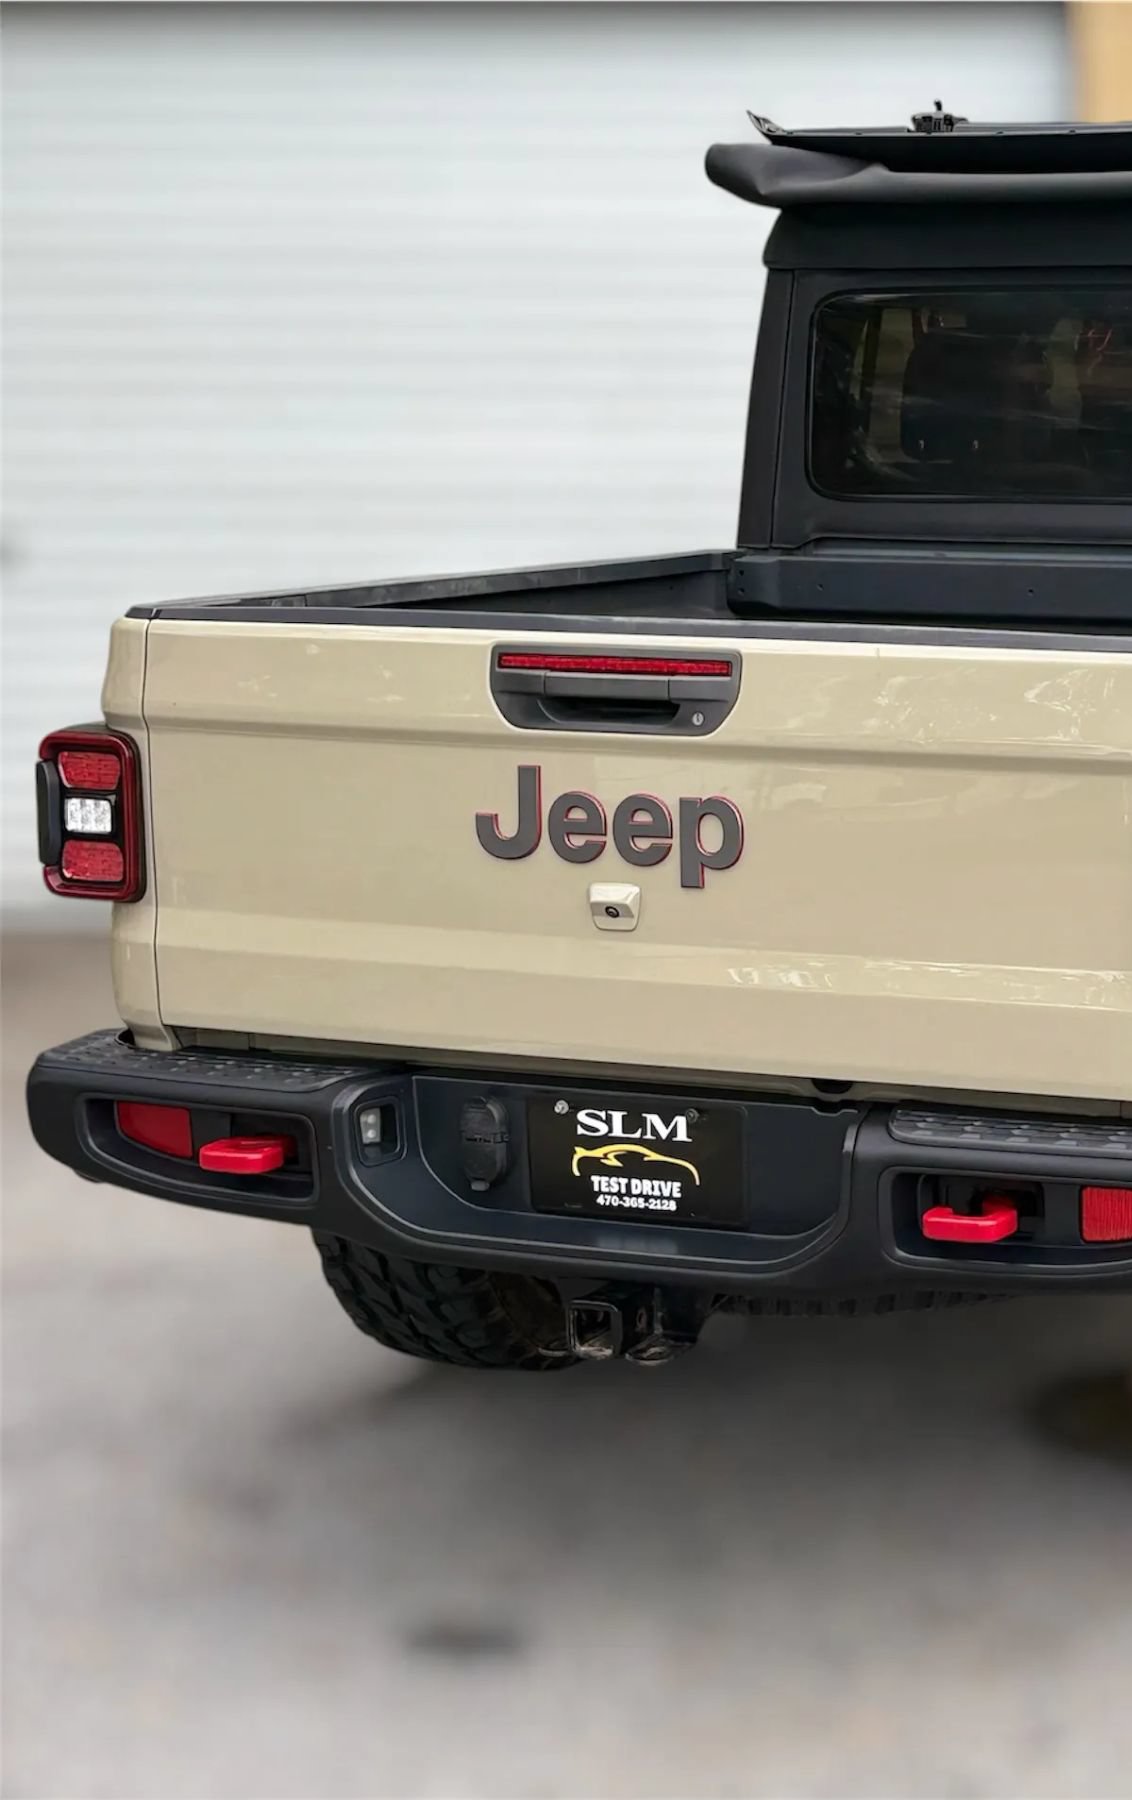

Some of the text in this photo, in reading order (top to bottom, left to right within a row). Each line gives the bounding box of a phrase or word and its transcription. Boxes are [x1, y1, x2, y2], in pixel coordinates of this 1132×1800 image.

[475, 764, 744, 889] Jeep
[576, 1108, 692, 1142] SLM
[590, 1174, 682, 1198] TEST DRIVE
[596, 1194, 677, 1211] 470-365-2128
